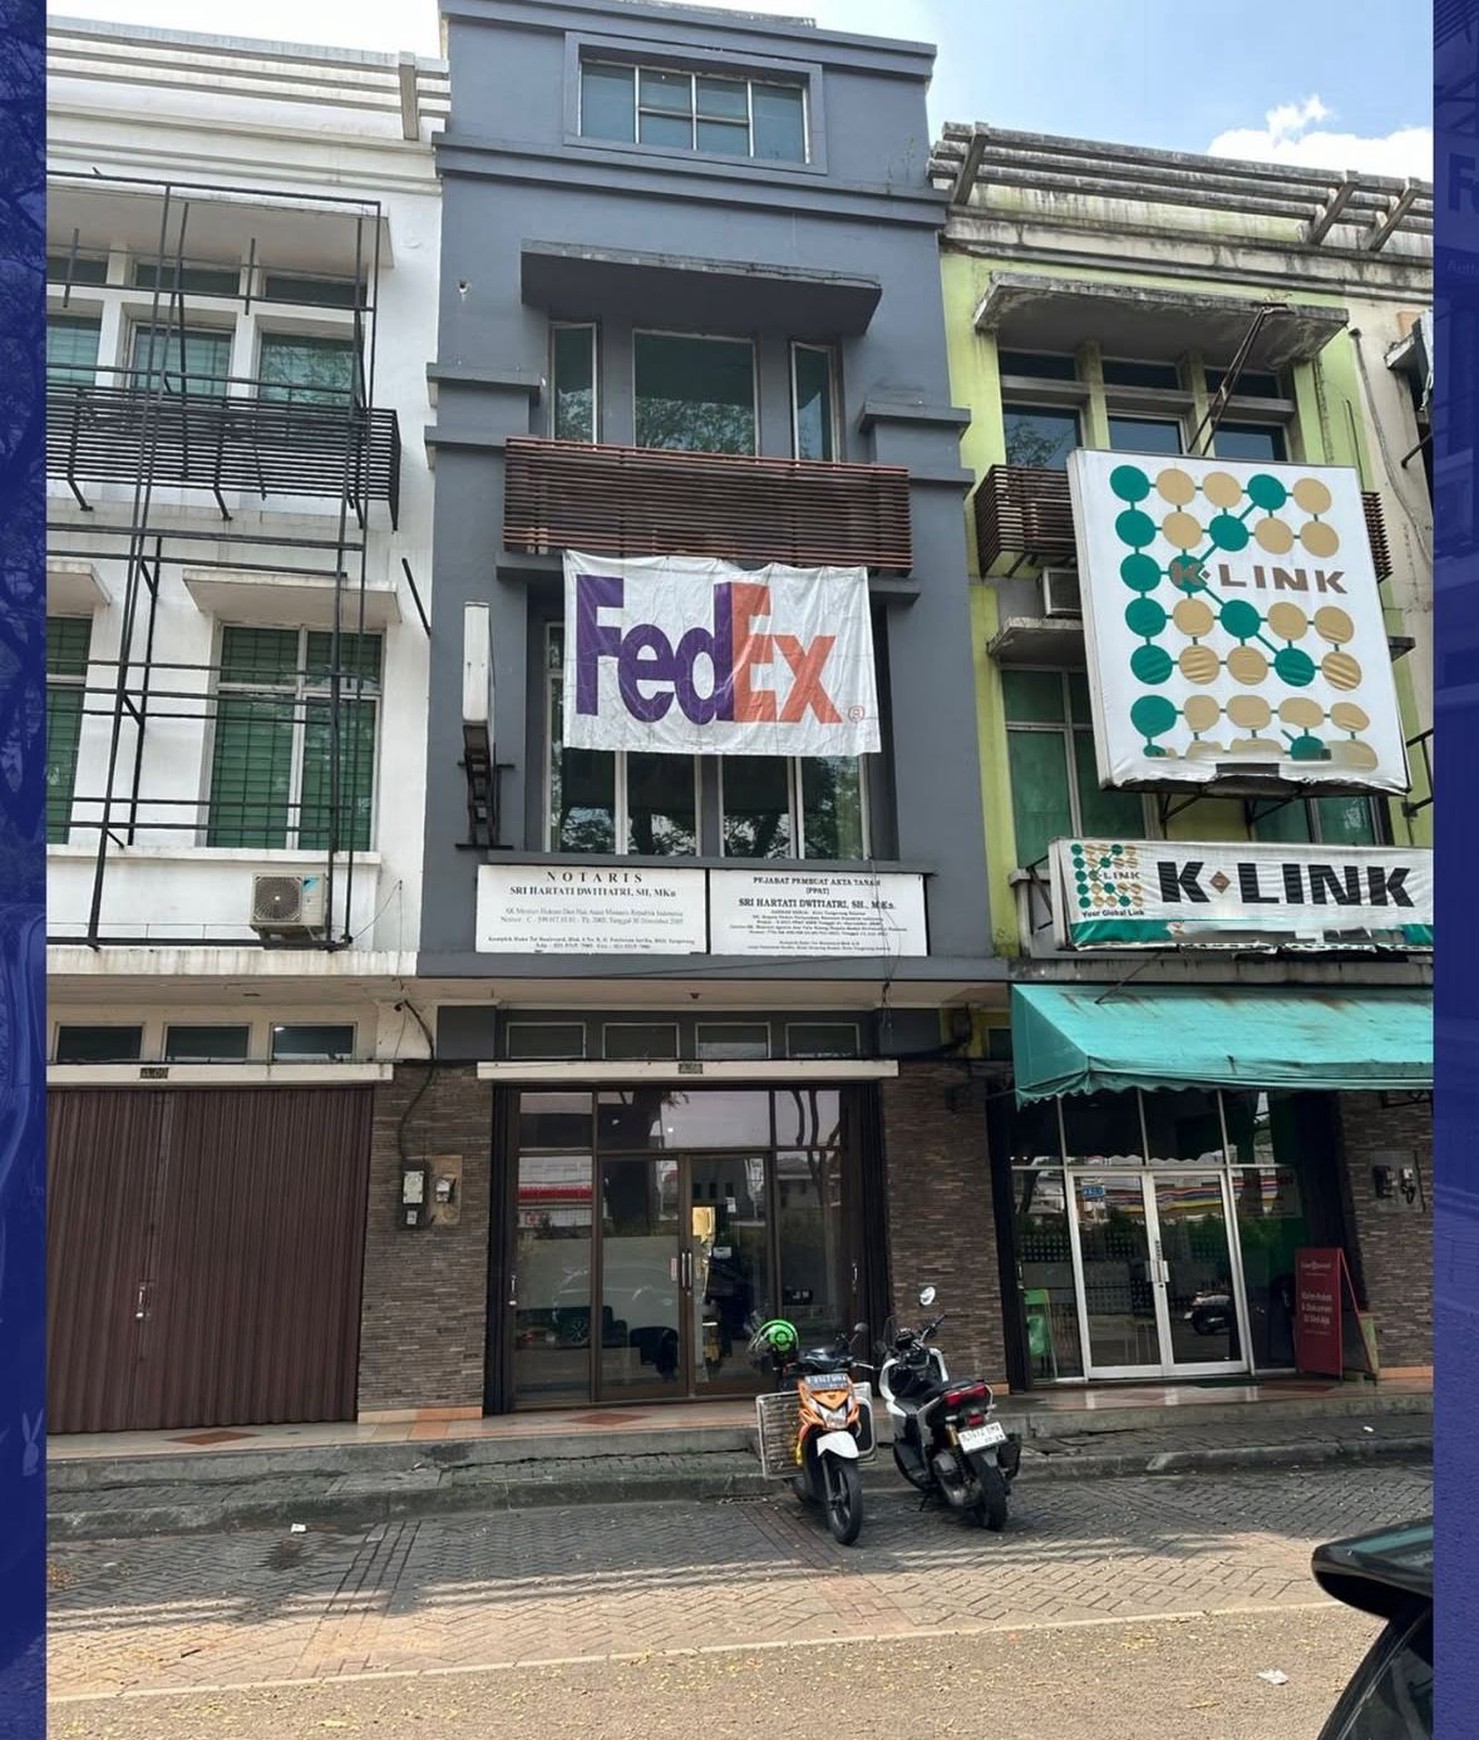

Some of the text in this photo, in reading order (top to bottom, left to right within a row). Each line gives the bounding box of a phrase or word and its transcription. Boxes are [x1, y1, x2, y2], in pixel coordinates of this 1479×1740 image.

[576, 574, 842, 724] FedEx
[547, 871, 643, 883] NOTARIS
[753, 876, 790, 885] PEJABAT
[791, 877, 828, 885] PEMBUAT
[831, 878, 852, 886] AKTA
[510, 886, 527, 896] SRI
[530, 886, 575, 896] HARTATI
[805, 887, 829, 896] (PPAT)
[738, 898, 754, 907] SRI
[756, 898, 797, 908] HARTATI
